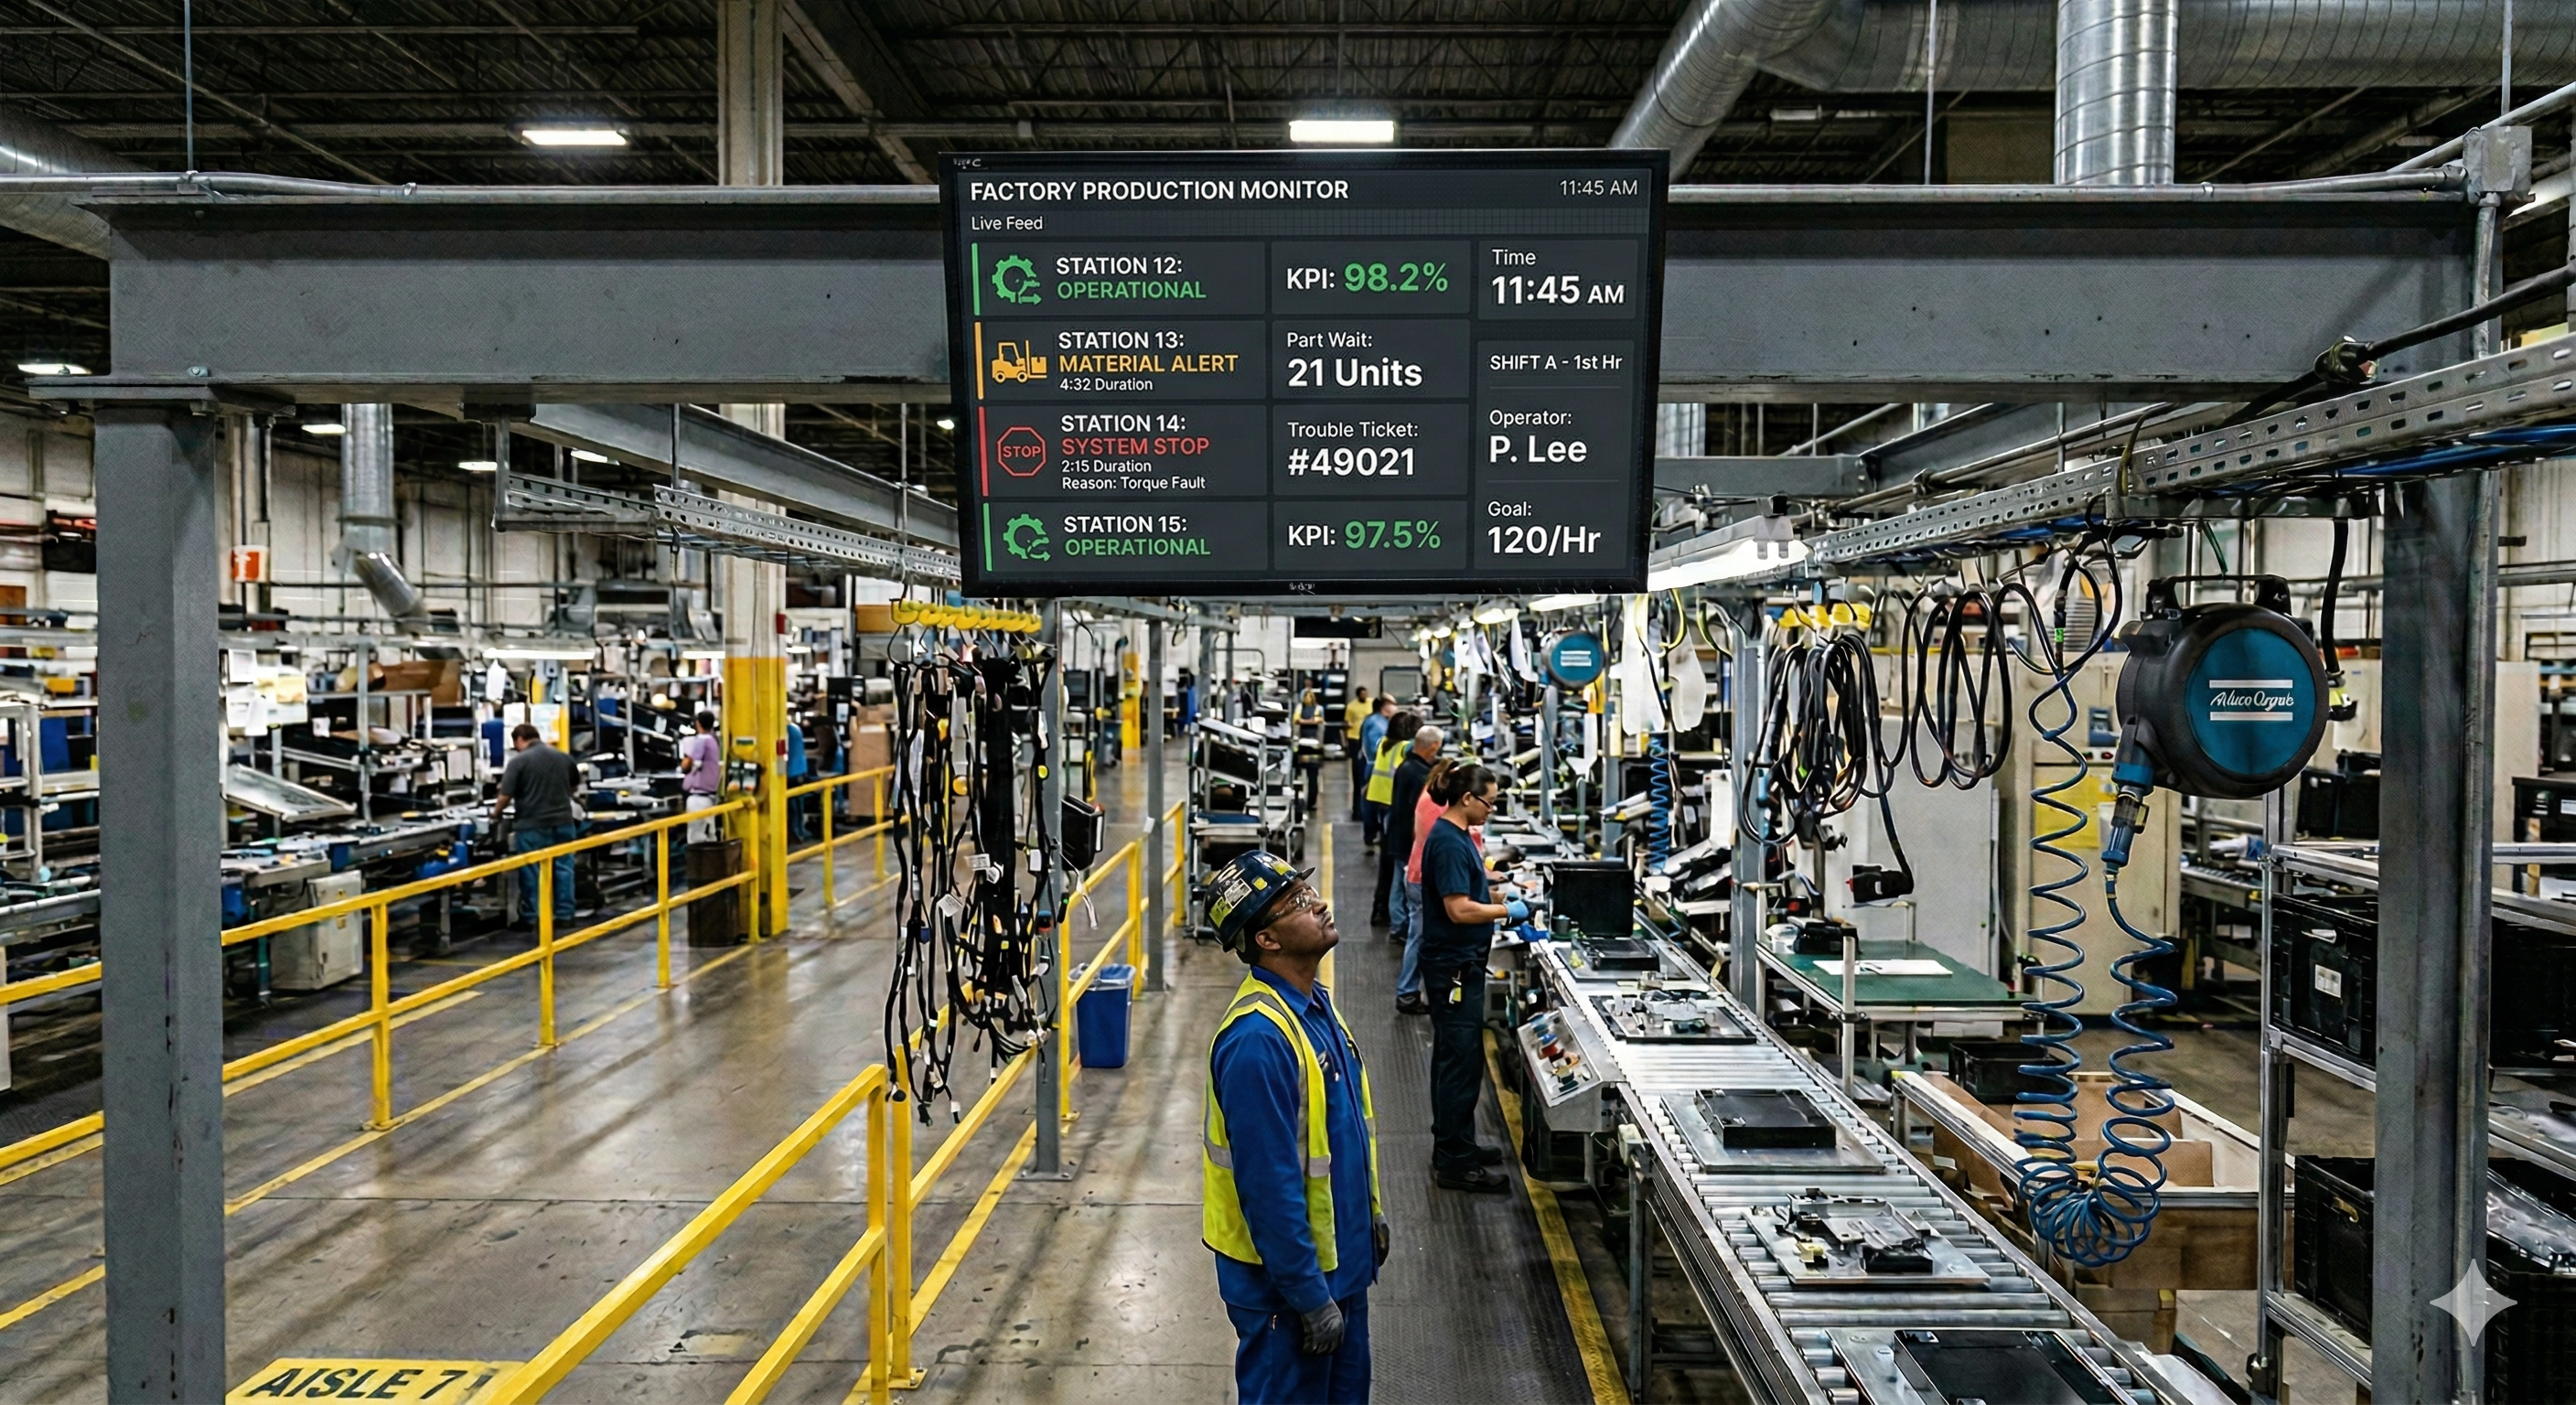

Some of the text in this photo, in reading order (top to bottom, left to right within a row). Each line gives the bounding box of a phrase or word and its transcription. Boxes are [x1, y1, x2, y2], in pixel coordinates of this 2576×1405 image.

[971, 179, 1349, 201] FACTORY PRODUCTION MONITOR
[1560, 179, 1637, 196] 11:45 AM
[971, 216, 1043, 231] Live Feed
[1056, 256, 1183, 275] STATION 12:
[1491, 249, 1537, 265] Time
[1287, 262, 1448, 292] KPI: 98.2%
[1057, 281, 1207, 299] OPERATIONAL
[1492, 275, 1625, 305] 11:45 AM
[1058, 330, 1185, 349] STATION 13:
[1287, 331, 1372, 349] Part Wait:
[1059, 354, 1239, 372] MATERIAL ALERT
[1489, 354, 1540, 370] SHIFT
[1544, 355, 1558, 370] A
[1573, 354, 1598, 370] 1st
[1602, 354, 1623, 370] Hr
[1288, 357, 1422, 387] 21 Units
[1059, 377, 1154, 391] 4:32 Duration
[1061, 413, 1186, 433] STATION 14:
[1489, 409, 1572, 429] Operator:
[1287, 421, 1419, 438] Trouble Ticket:
[1003, 445, 1042, 458] STOP
[1062, 437, 1209, 456] SYSTEM STOP
[1489, 434, 1587, 463] P. Lee
[1061, 459, 1152, 473] 2:15 Duration
[1287, 447, 1415, 477] #49021
[1062, 476, 1206, 493] Reason: Torque Fault
[1487, 500, 1532, 517] Goal:
[1064, 515, 1187, 533] STATION 15:
[1288, 520, 1442, 549] KPI: 97.5%
[1487, 524, 1602, 557] 120/Hr
[1065, 538, 1211, 556] OPERATIONAL
[246, 1367, 424, 1399] AISLE
